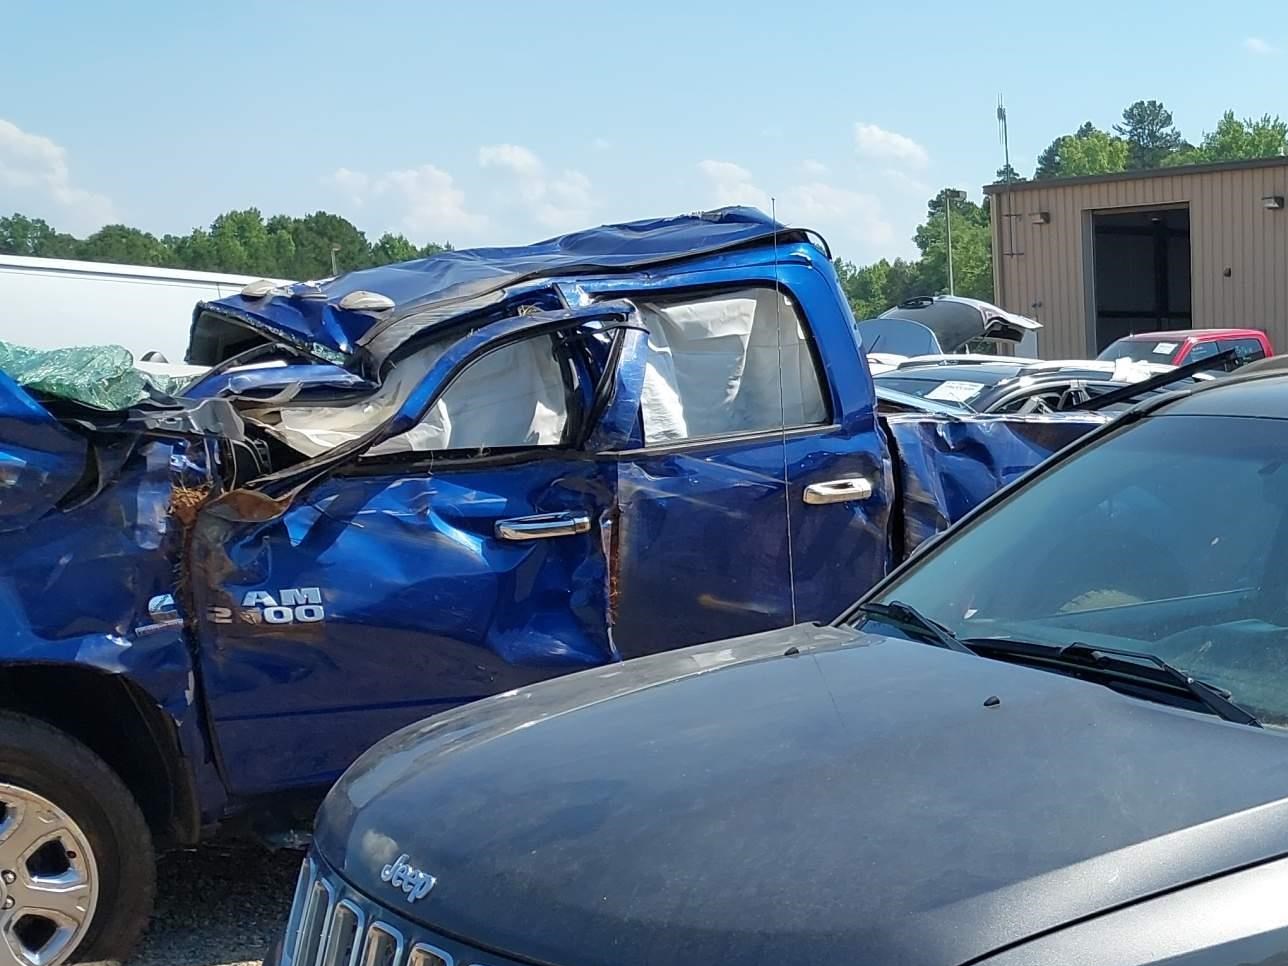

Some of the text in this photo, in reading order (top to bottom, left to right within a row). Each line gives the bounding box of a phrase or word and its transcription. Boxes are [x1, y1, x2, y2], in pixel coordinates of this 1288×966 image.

[241, 587, 322, 606] AM
[207, 605, 325, 624] 200
[381, 853, 436, 903] Jeep
